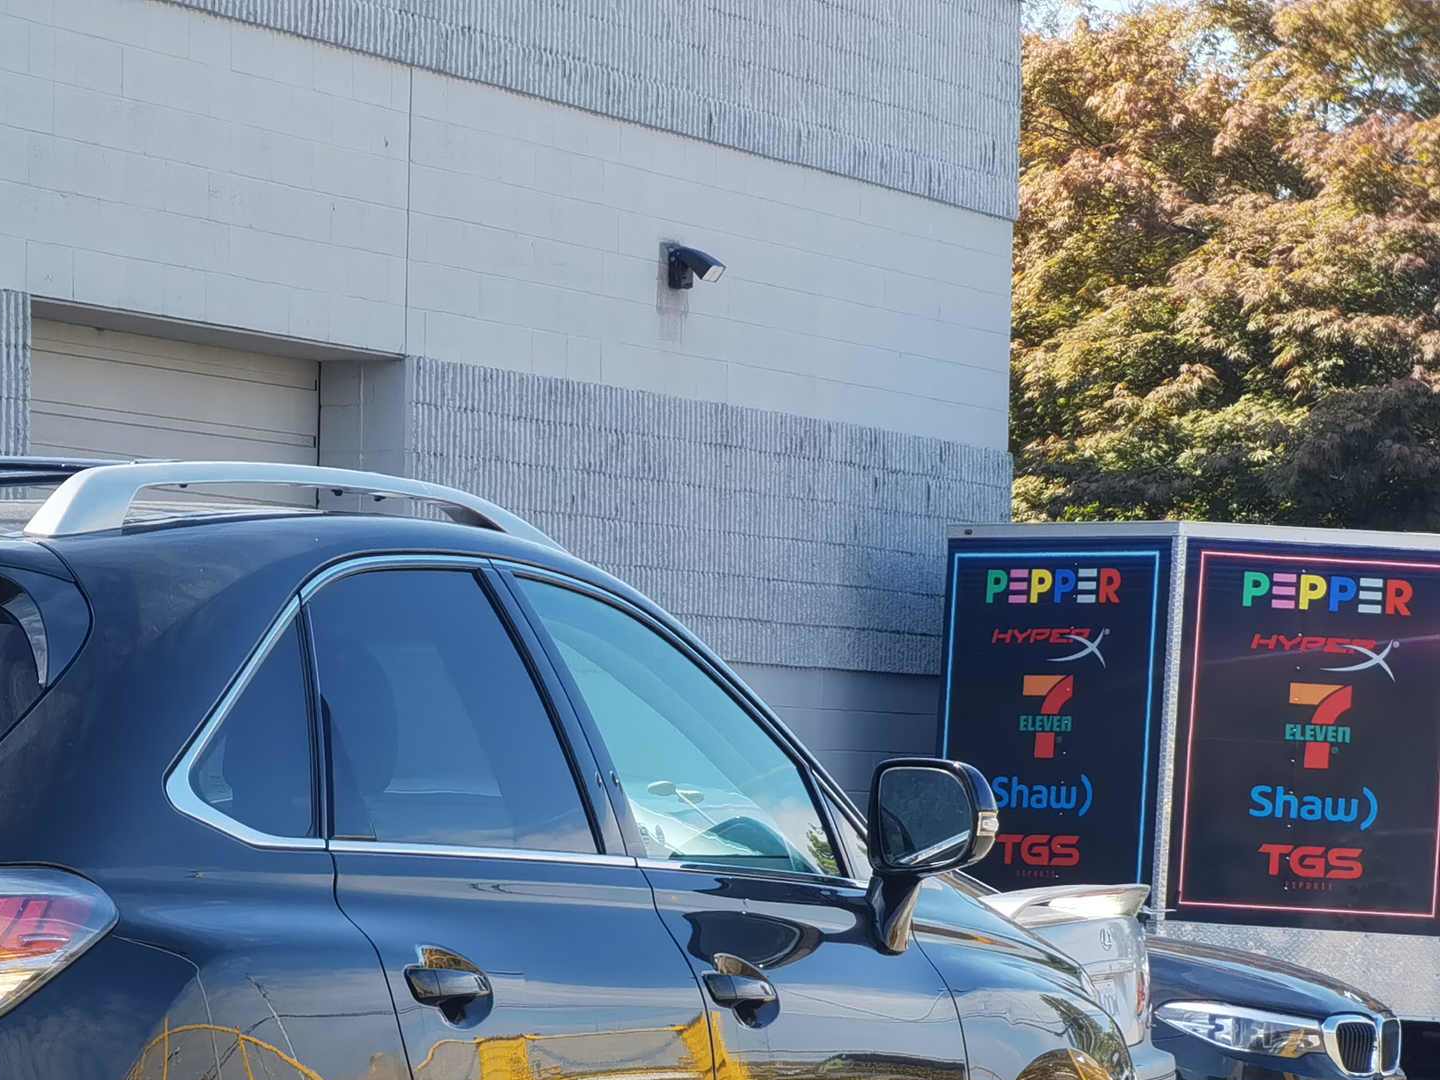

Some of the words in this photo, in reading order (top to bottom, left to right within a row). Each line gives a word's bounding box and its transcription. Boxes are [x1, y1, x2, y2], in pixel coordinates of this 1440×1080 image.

[985, 568, 1122, 604] PEPPER
[1242, 570, 1414, 616] PEPPER
[995, 833, 1081, 866] TGS
[1258, 843, 1364, 880] TGS
